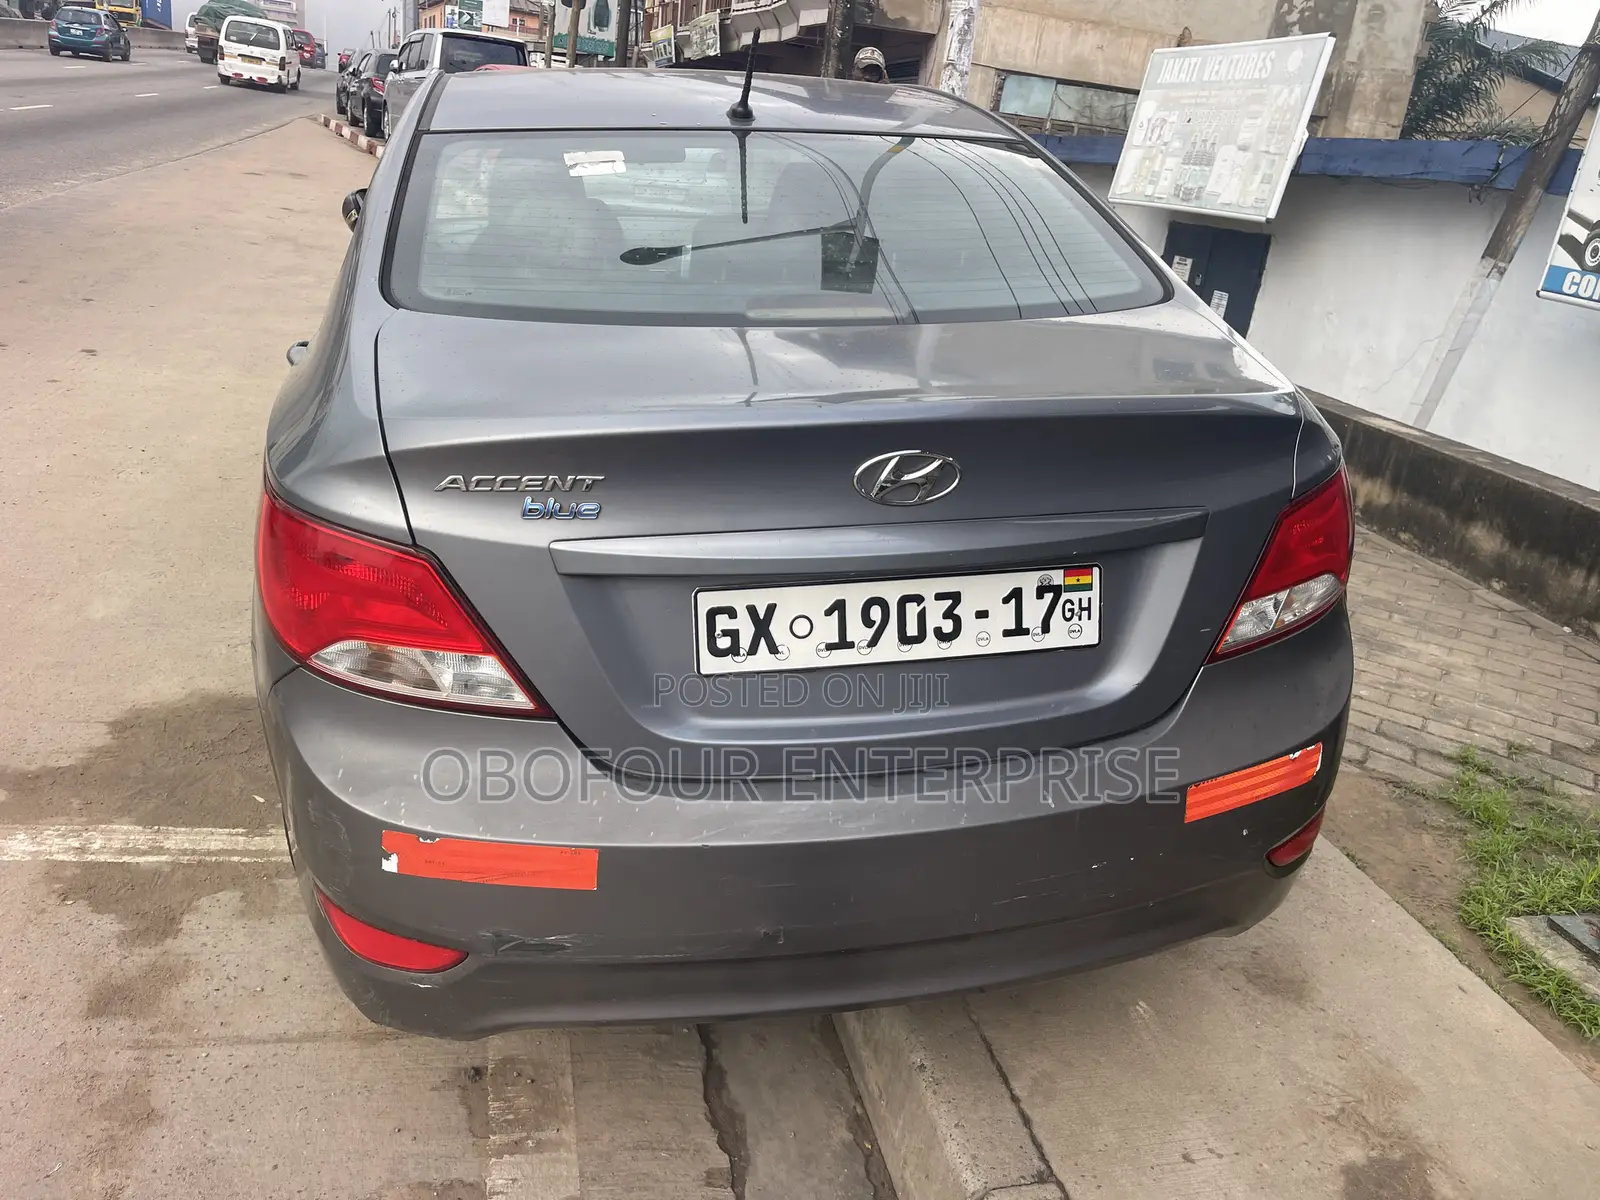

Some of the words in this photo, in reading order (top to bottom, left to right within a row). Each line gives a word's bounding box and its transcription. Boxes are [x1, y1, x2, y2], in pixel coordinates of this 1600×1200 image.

[1203, 50, 1276, 81] VENTURES
[434, 474, 606, 492] ACCENT
[521, 496, 602, 520] blue
[1061, 596, 1092, 623] GH
[705, 602, 779, 658] GX
